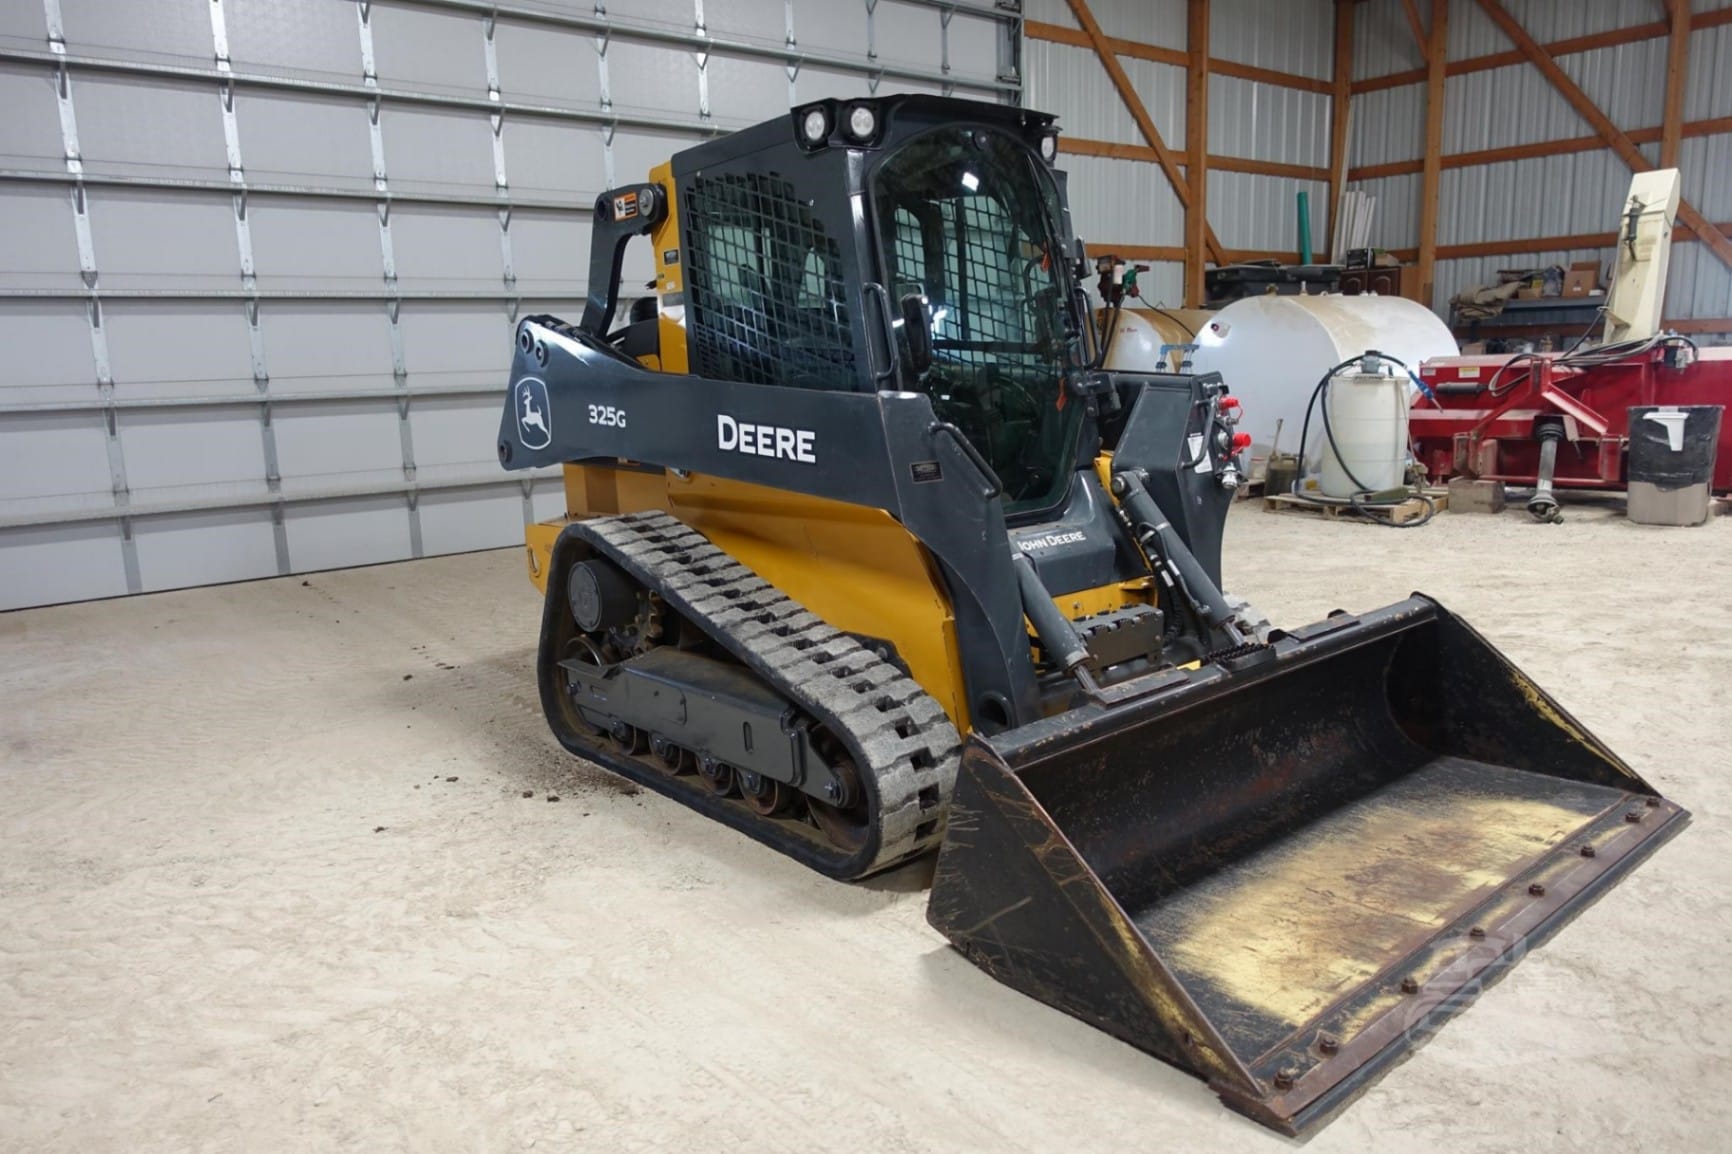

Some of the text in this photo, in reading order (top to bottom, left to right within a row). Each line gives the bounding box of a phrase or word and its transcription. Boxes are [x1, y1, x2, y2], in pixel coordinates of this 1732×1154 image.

[588, 404, 626, 428] 325G
[717, 414, 816, 463] DEERE
[1017, 531, 1087, 551] JOHN DEERE
